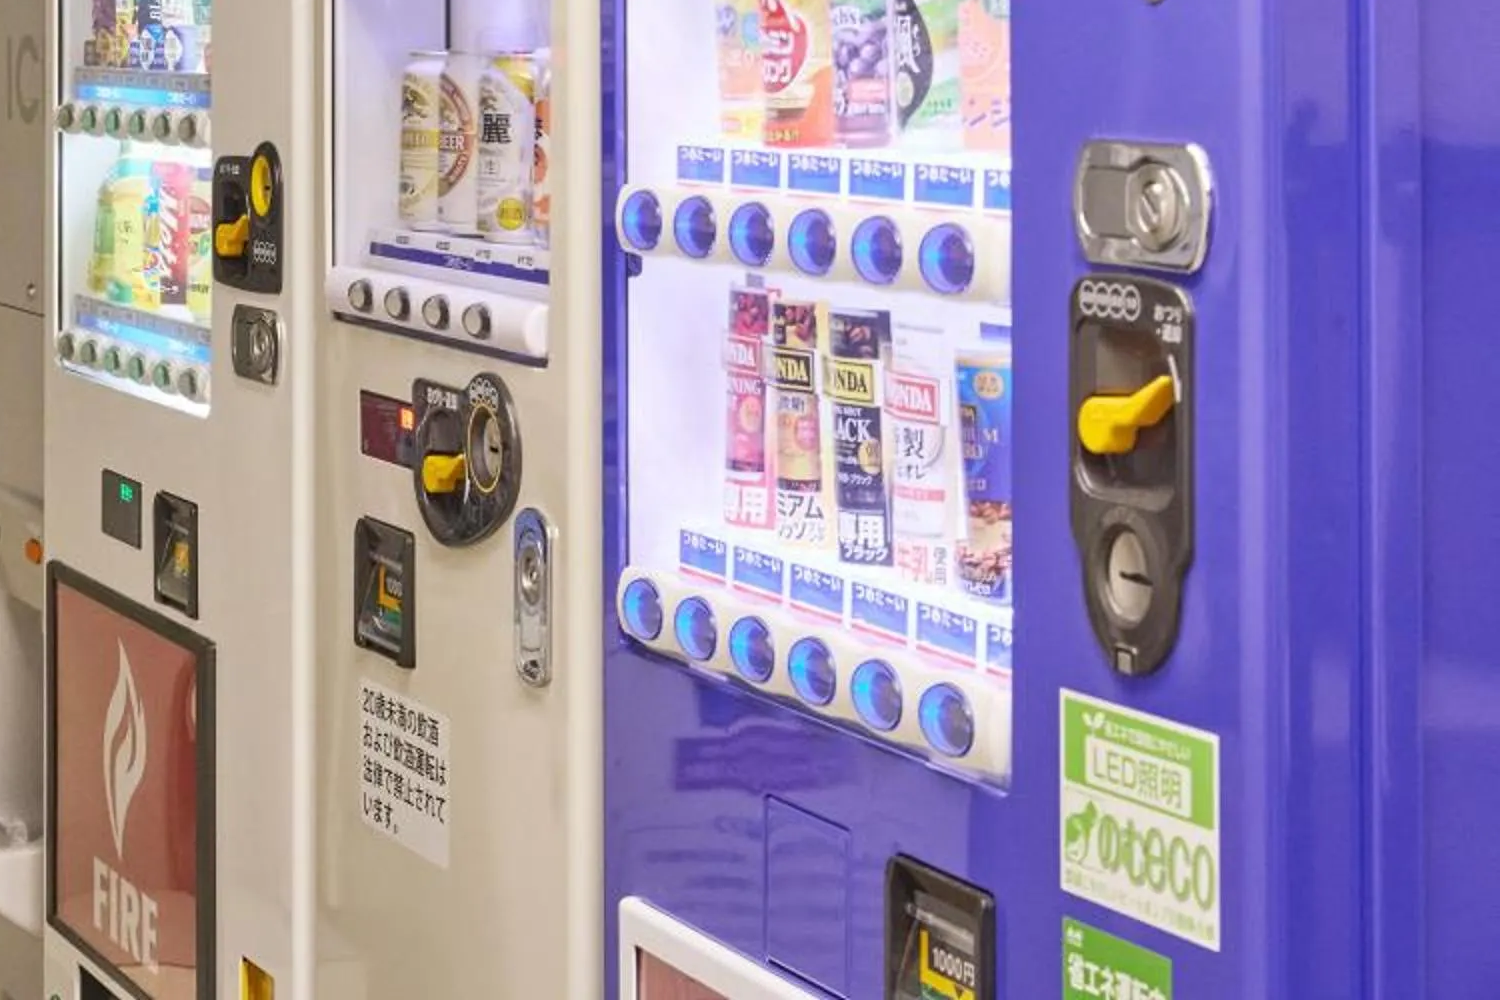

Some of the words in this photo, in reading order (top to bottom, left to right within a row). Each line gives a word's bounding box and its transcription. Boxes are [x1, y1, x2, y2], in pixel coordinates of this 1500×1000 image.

[362, 687, 440, 748] 20歳未満の飲酒
[1092, 745, 1183, 809] LED照明
[363, 791, 398, 835] います。
[93, 855, 159, 976] FIRE
